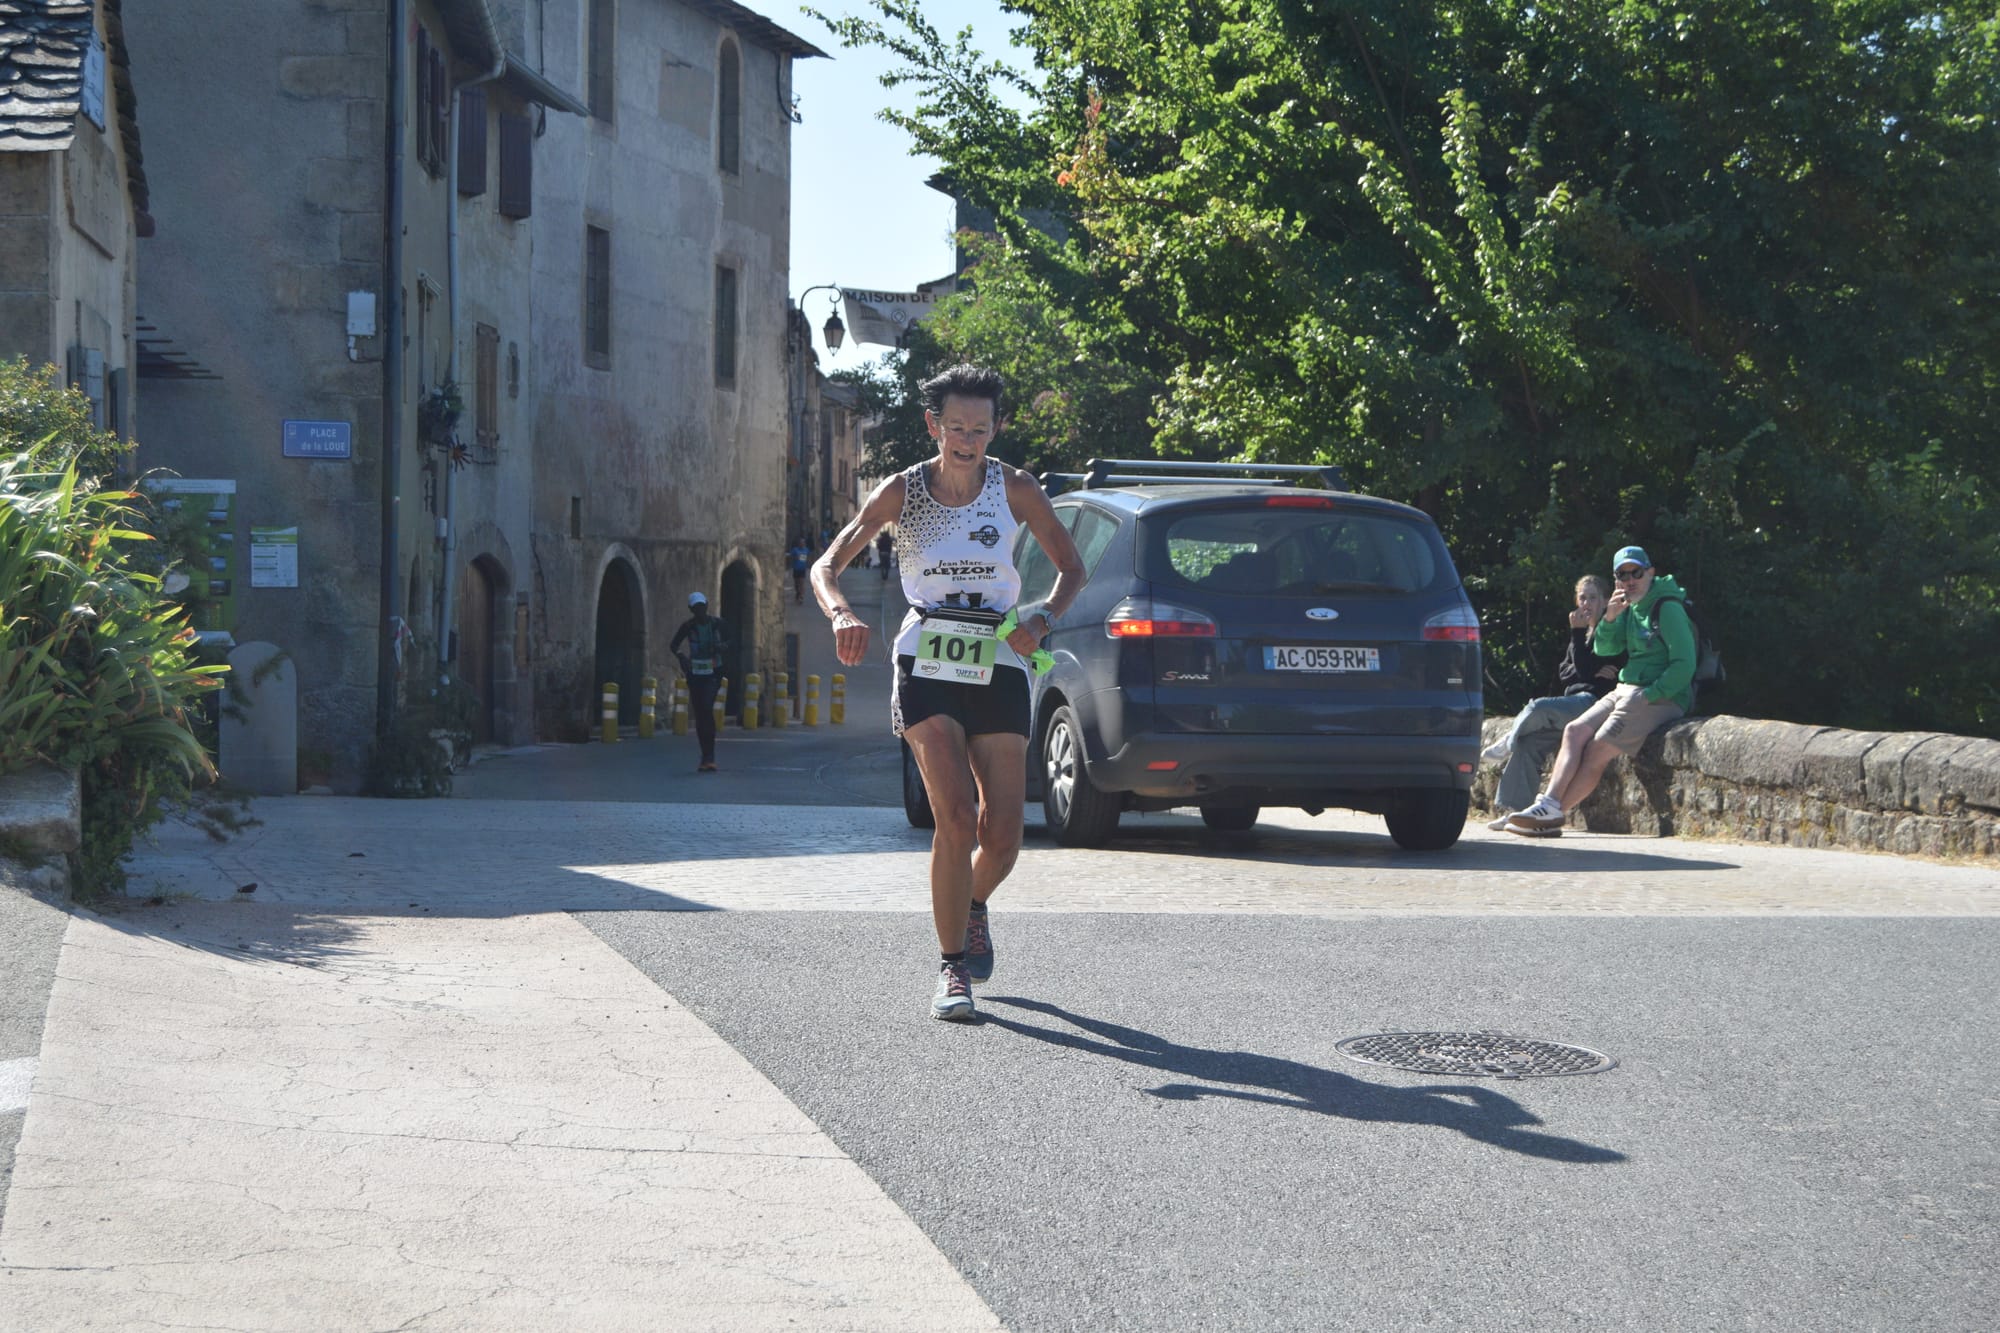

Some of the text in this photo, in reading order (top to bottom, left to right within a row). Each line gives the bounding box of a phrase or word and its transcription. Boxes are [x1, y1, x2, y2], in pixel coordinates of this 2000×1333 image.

[845, 291, 906, 303] MAISON
[911, 293, 930, 303] DE
[310, 427, 337, 438] PLACE
[301, 441, 345, 451] de la LOUE
[938, 559, 958, 568] Jean
[923, 566, 996, 577] GLEYZON
[928, 634, 983, 664] 101
[1276, 648, 1367, 668] AC-059-RW
